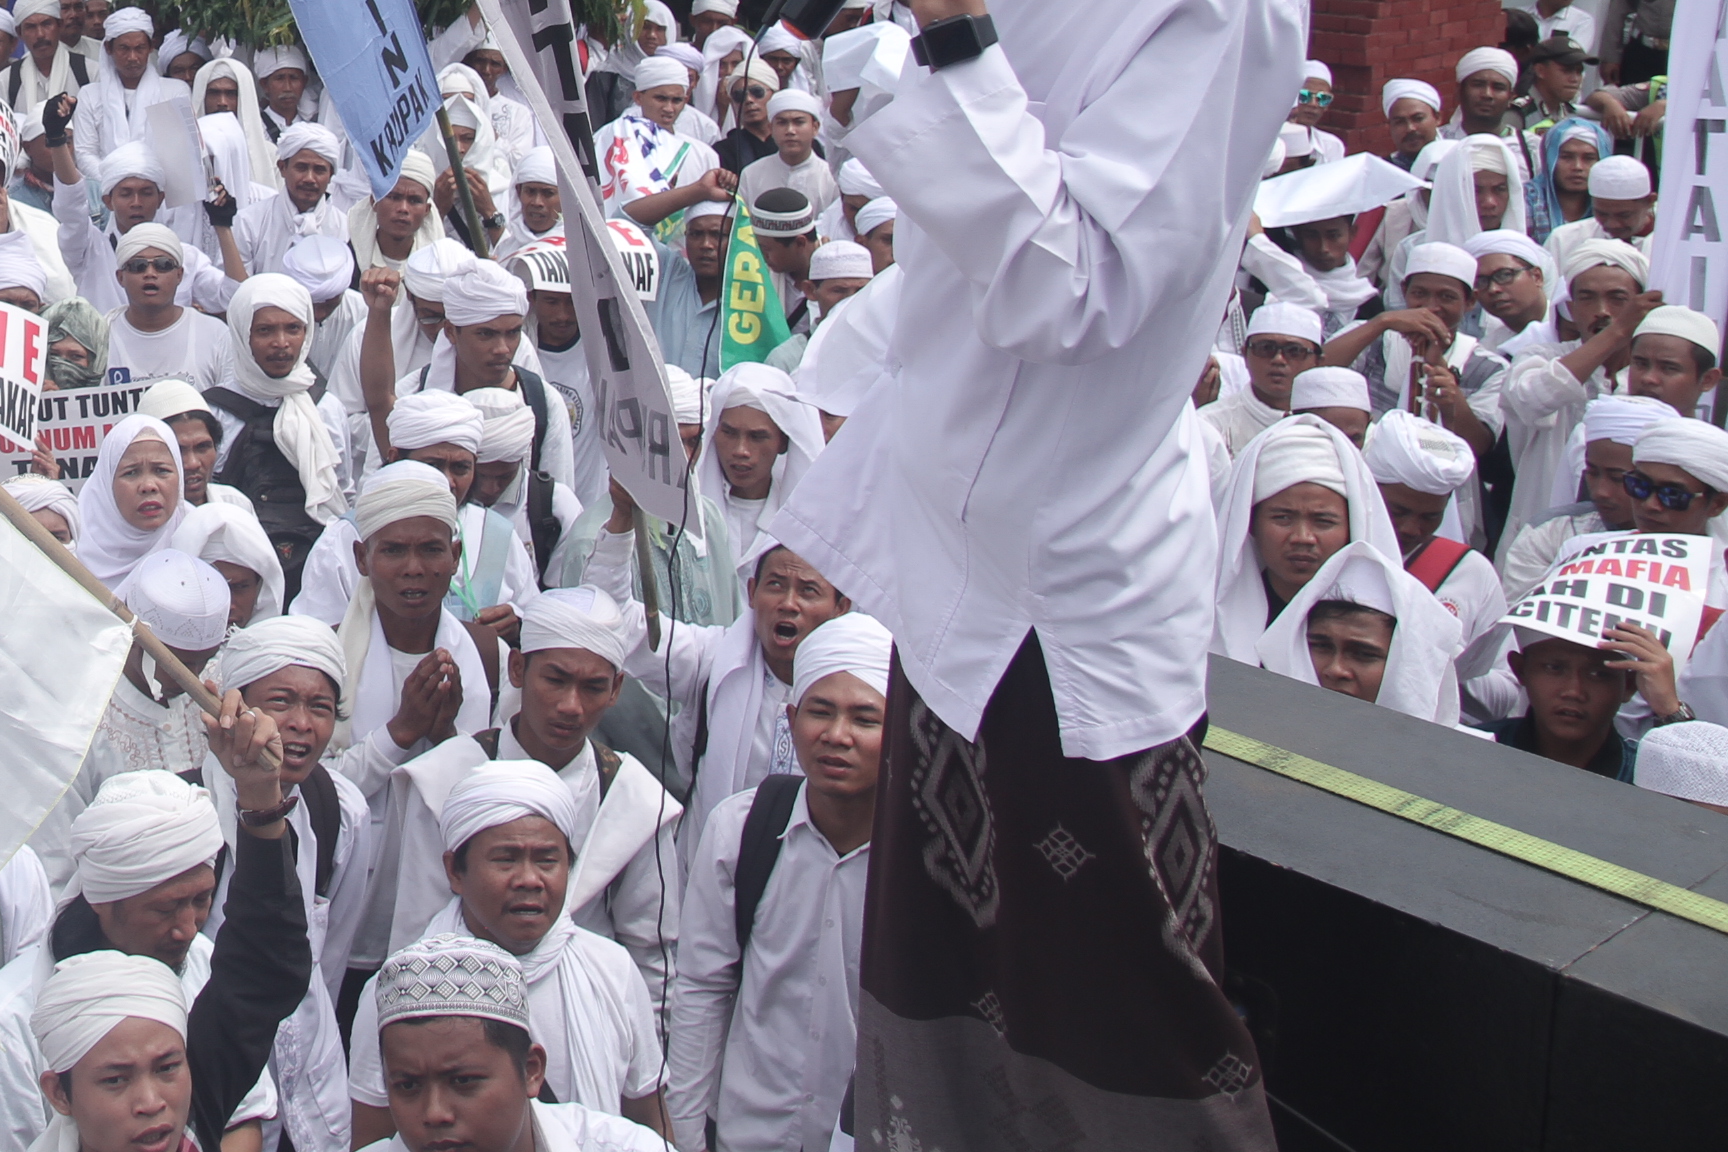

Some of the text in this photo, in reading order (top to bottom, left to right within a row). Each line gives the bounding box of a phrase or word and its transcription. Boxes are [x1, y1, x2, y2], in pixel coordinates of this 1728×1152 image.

[525, 249, 571, 284] TAN
[1558, 559, 1691, 591] MAFIA
[1605, 582, 1667, 619] DI
